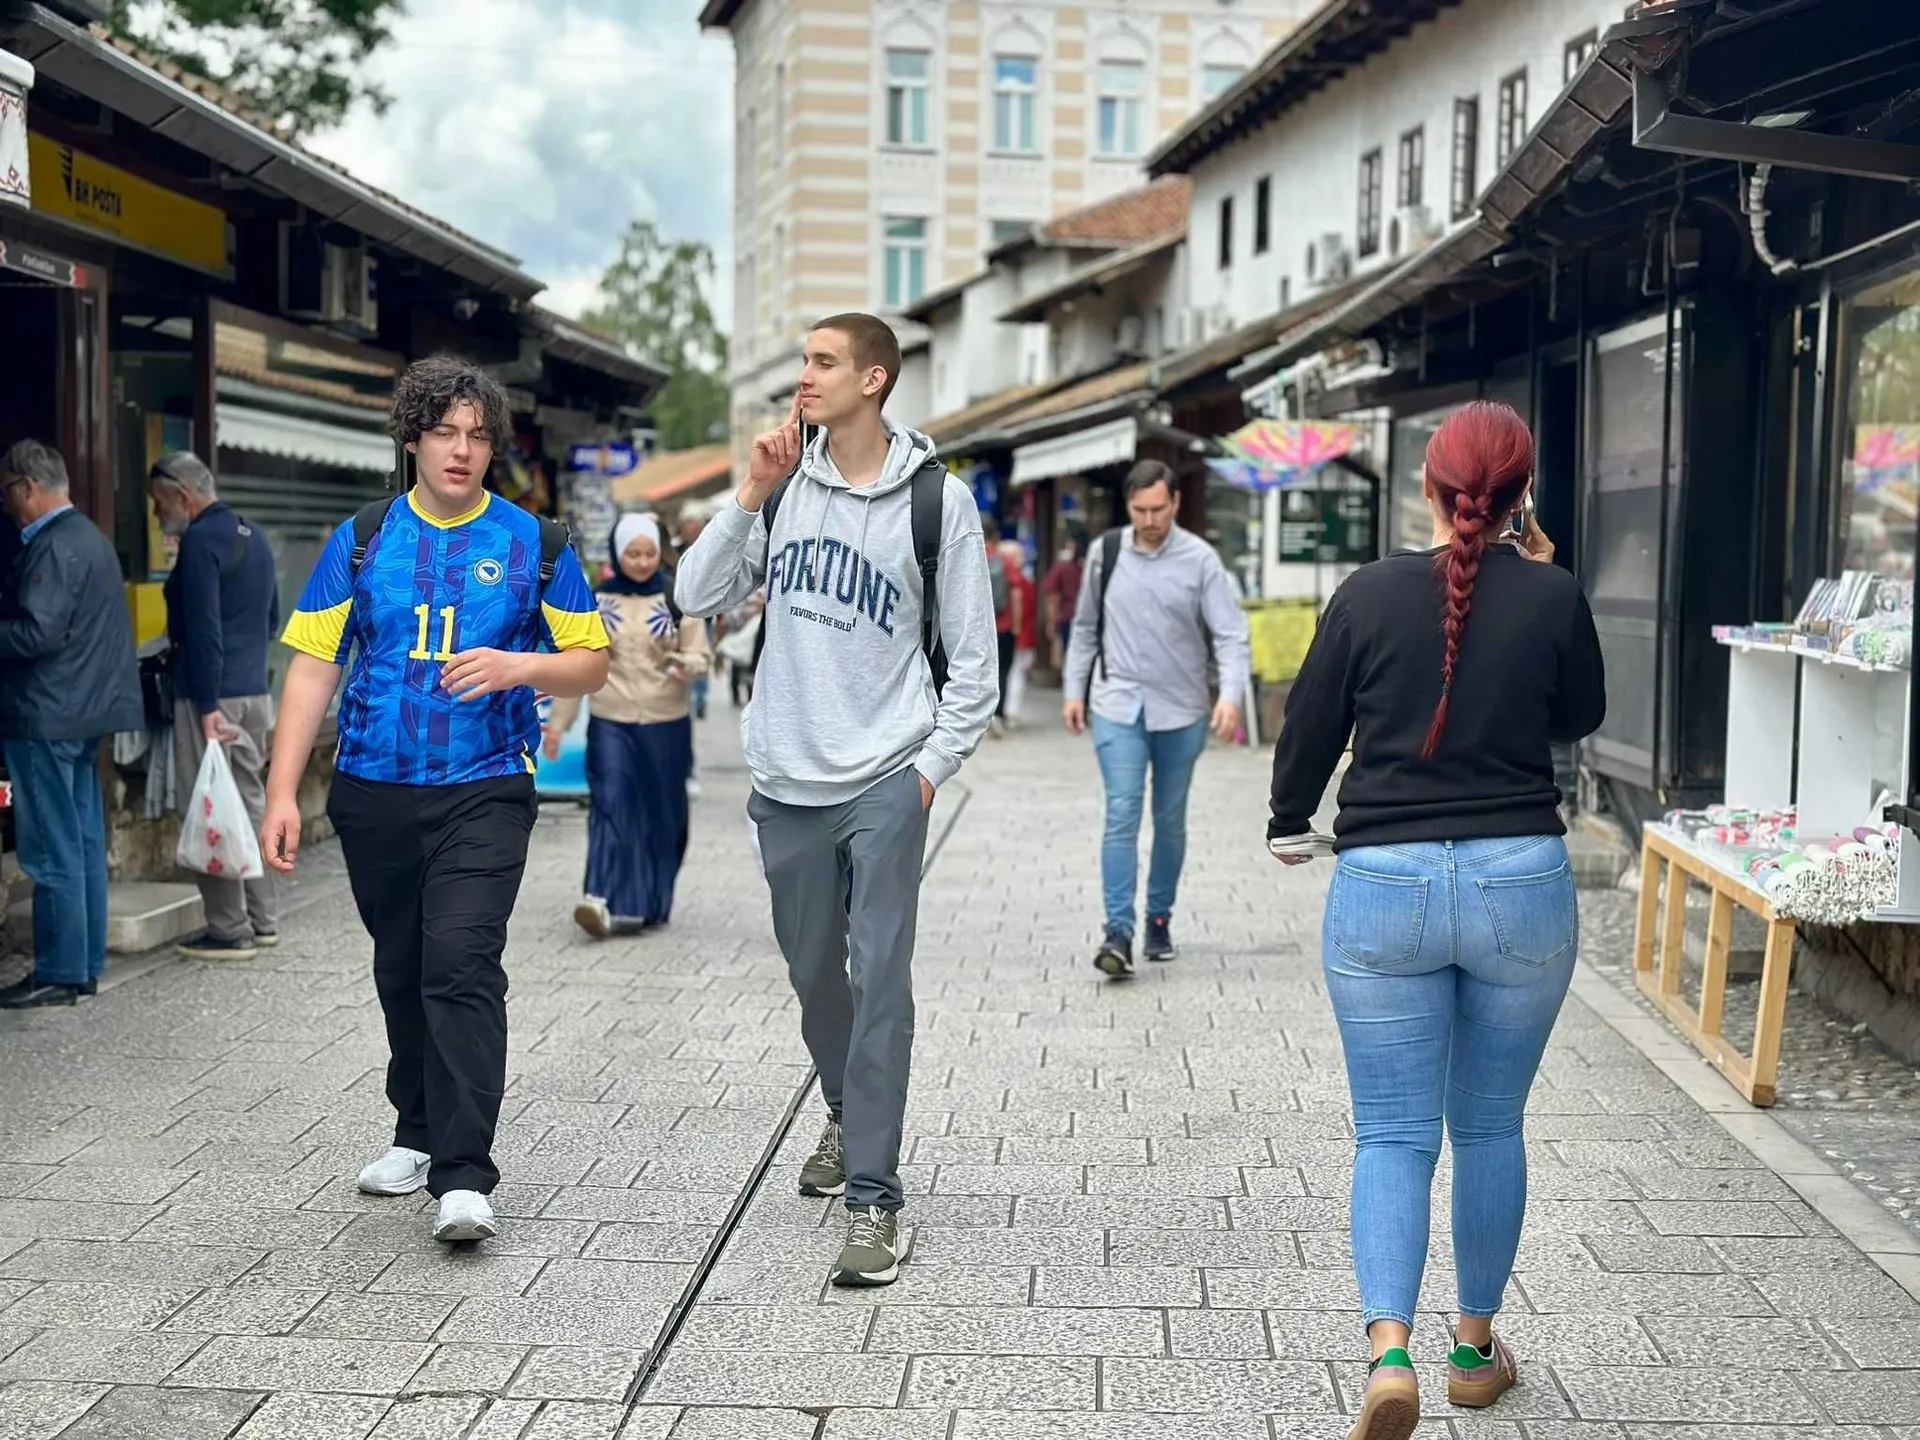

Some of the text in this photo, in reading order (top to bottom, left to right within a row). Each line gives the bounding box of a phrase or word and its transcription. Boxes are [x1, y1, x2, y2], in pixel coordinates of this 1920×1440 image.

[75, 178, 91, 205] BH
[766, 535, 901, 639] FORTUNE
[409, 603, 457, 661] 11
[789, 606, 852, 633] FAVORS THE BOLD
